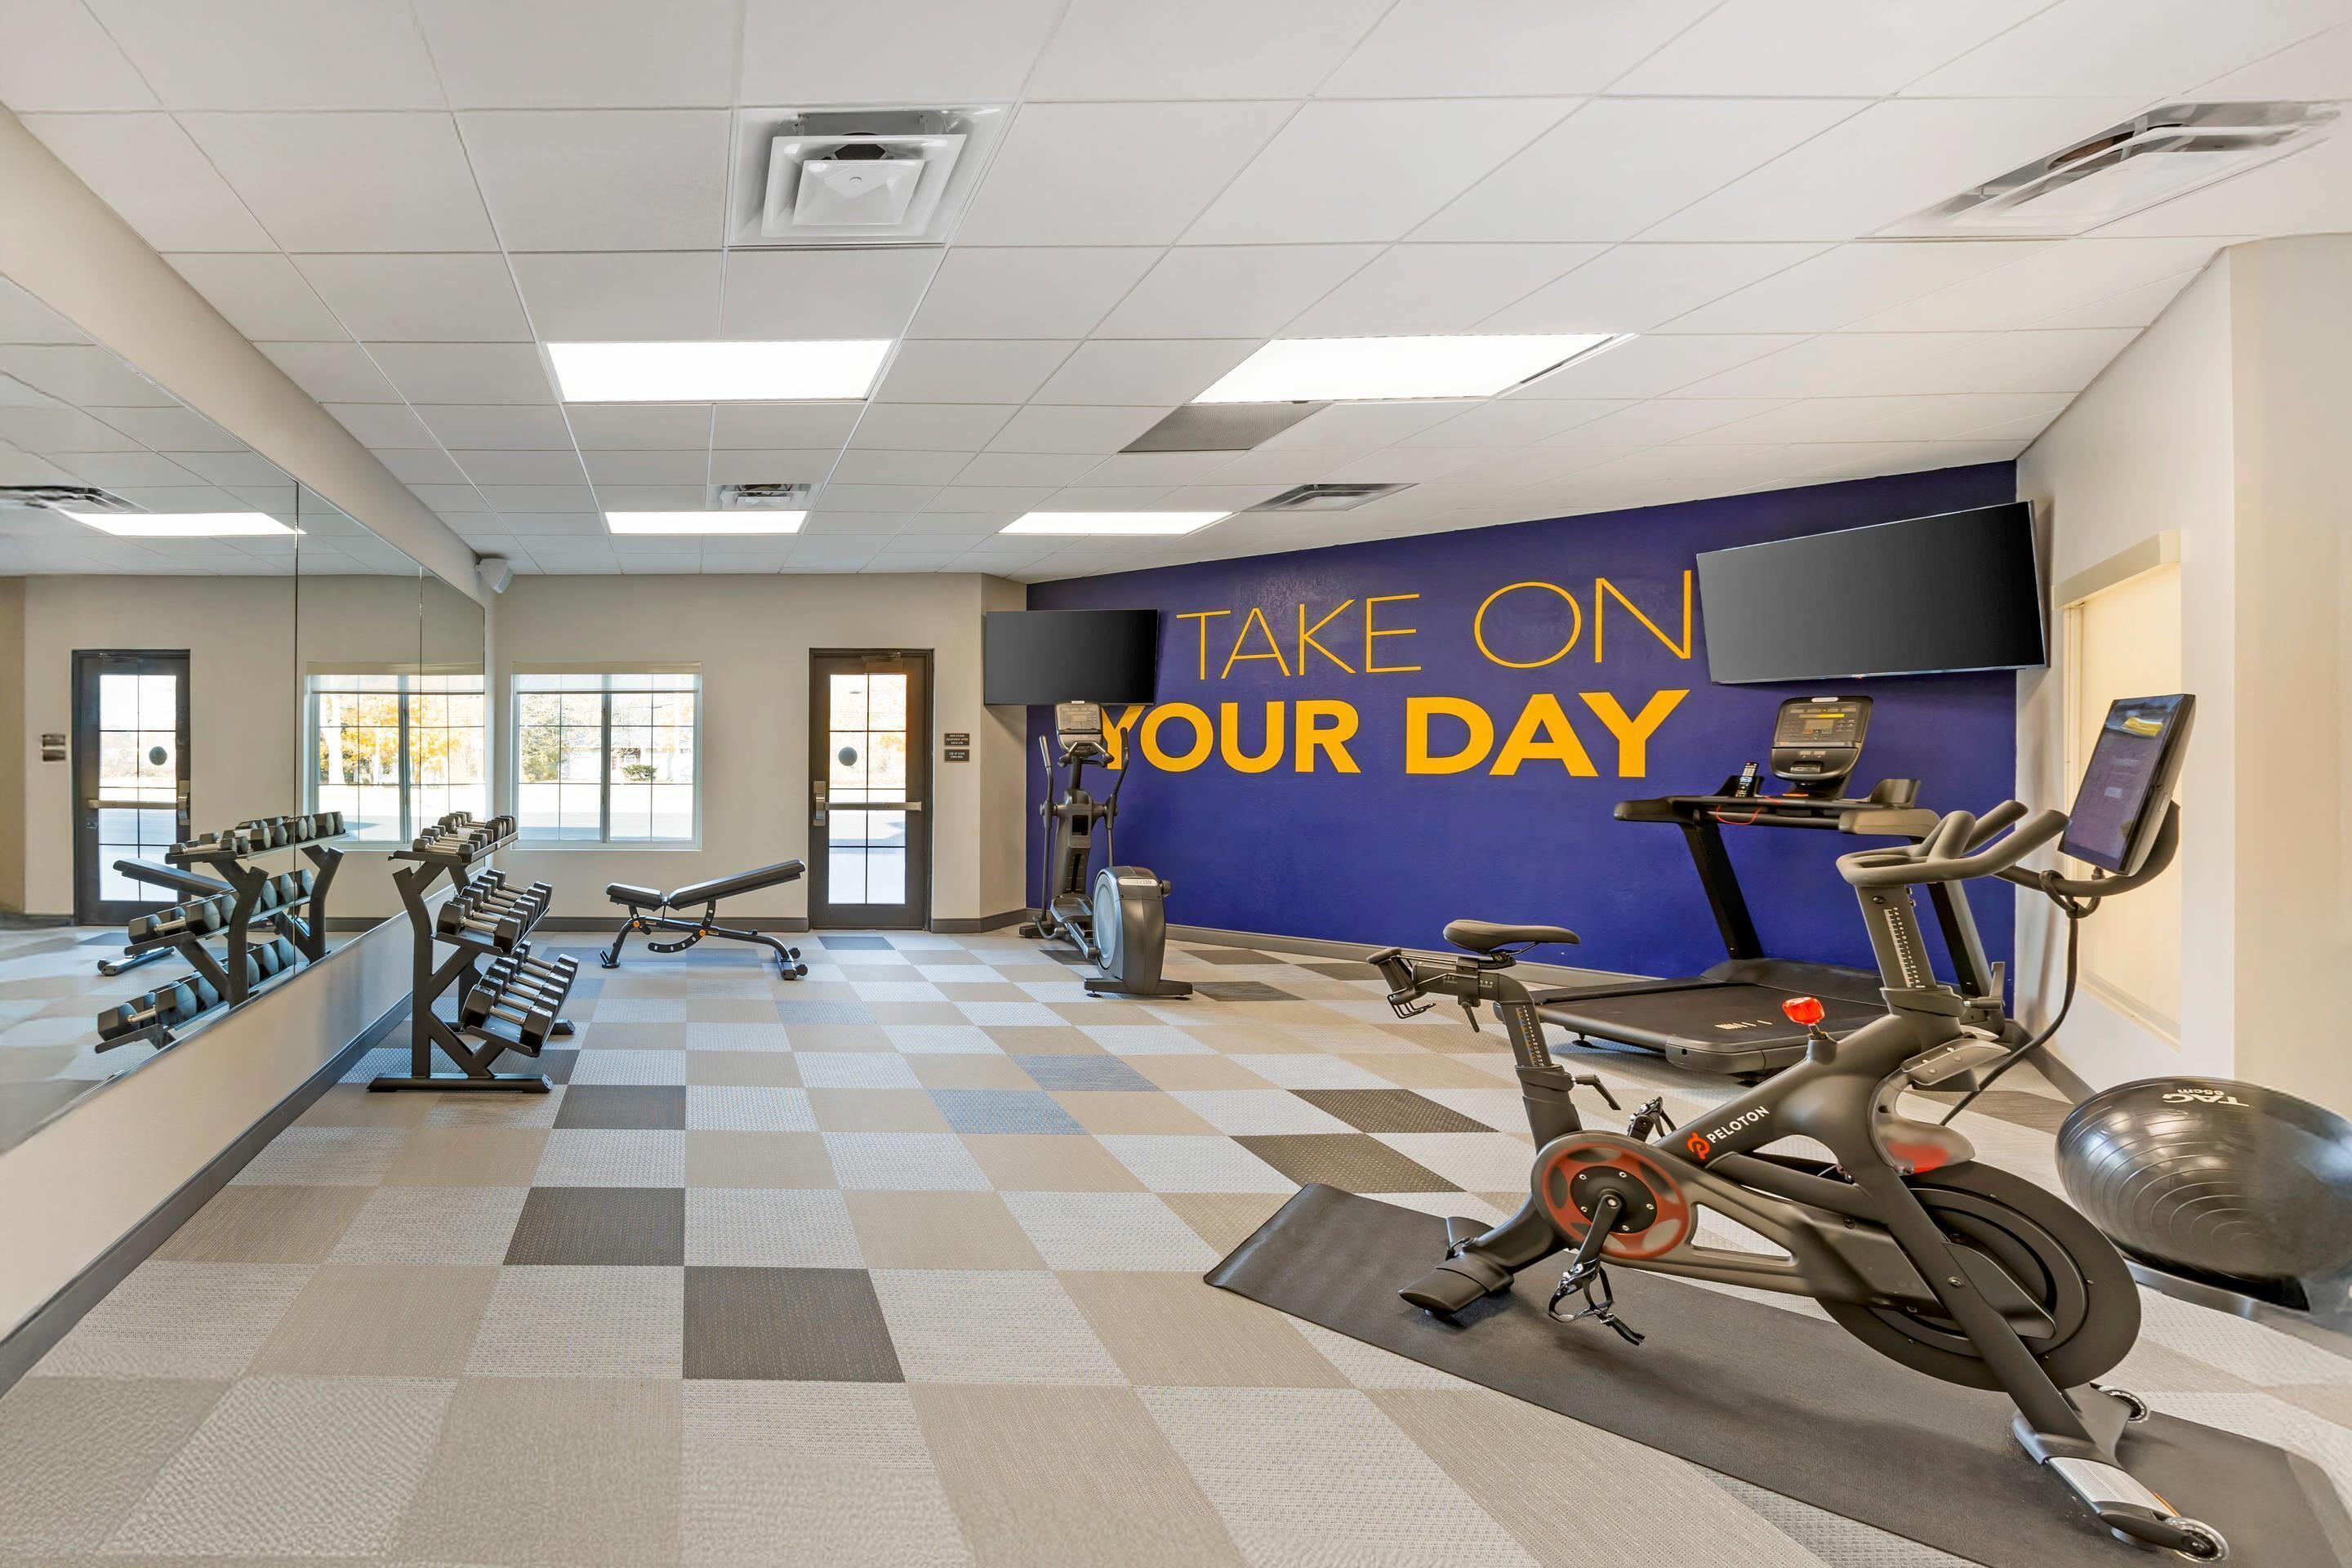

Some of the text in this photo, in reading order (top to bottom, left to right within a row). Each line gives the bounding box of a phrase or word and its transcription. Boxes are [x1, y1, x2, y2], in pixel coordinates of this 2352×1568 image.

[1176, 570, 1692, 680] TAKE ON
[1102, 689, 1690, 777] YOUR DAY
[1706, 1106, 1771, 1143] PELOTON
[2162, 1094, 2250, 1107] TAG
